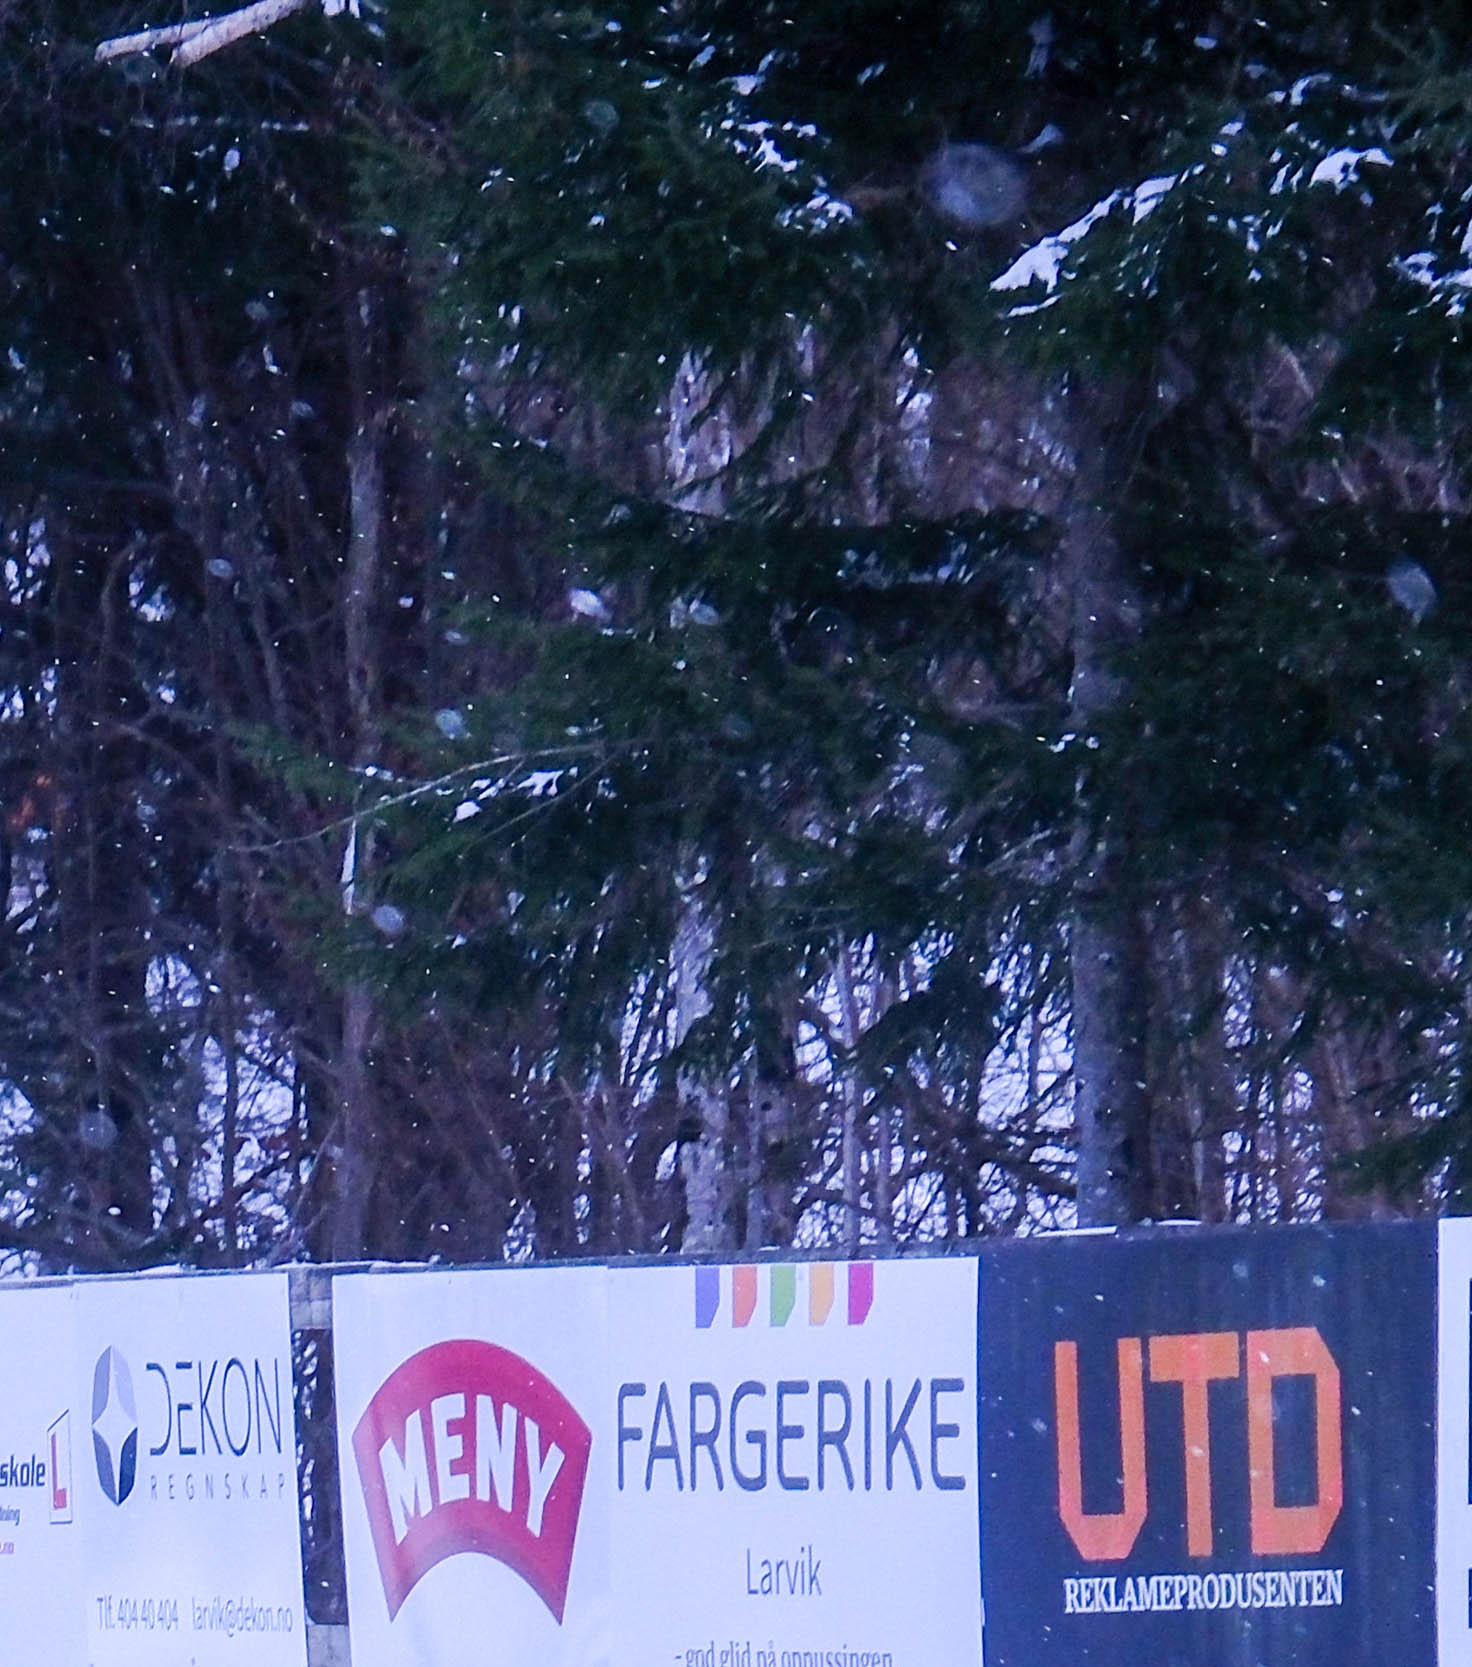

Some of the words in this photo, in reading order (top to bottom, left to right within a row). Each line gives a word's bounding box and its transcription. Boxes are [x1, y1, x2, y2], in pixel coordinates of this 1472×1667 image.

[146, 1357, 282, 1457] DEKON
[617, 1377, 966, 1492] FARGERIKE
[1055, 1326, 1343, 1560] UTD
[150, 1473, 284, 1500] REGNSKAP
[379, 1392, 565, 1545] MENY
[746, 1545, 823, 1596] Larvik
[1063, 1569, 1344, 1614] REKLAMEPRODUSENTEN
[118, 1598, 138, 1630] 404
[141, 1598, 155, 1630] 40
[157, 1598, 178, 1631] 404
[191, 1596, 293, 1638] larvik@dekon.no
